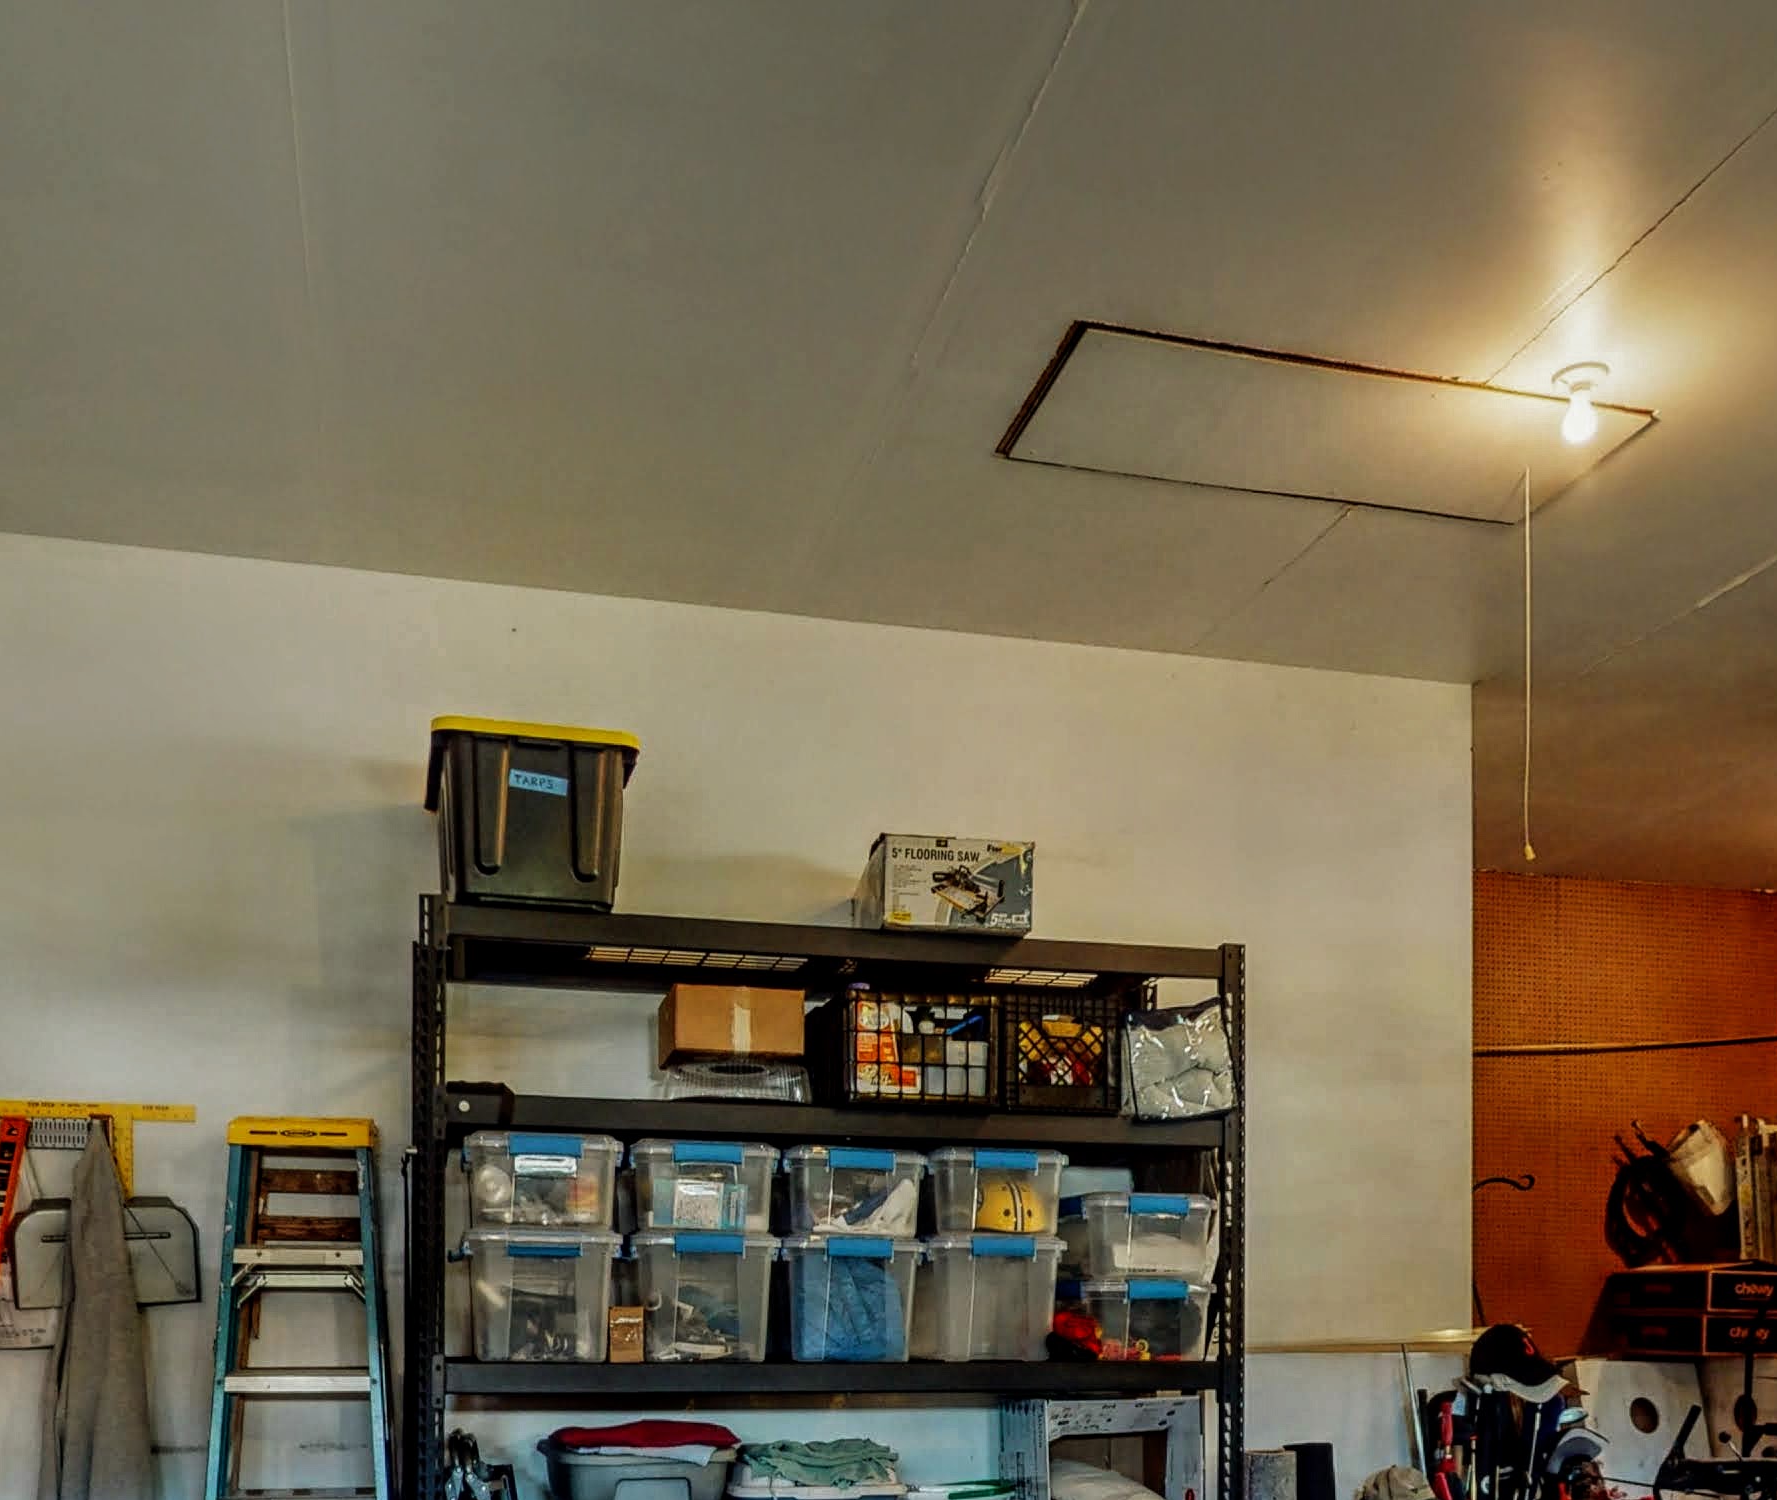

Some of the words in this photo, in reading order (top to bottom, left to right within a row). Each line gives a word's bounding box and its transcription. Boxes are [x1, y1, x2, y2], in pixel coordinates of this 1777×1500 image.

[514, 773, 554, 790] TARPS
[904, 848, 954, 861] FLOORING
[957, 850, 980, 862] SAW
[1734, 1281, 1774, 1297] chewy
